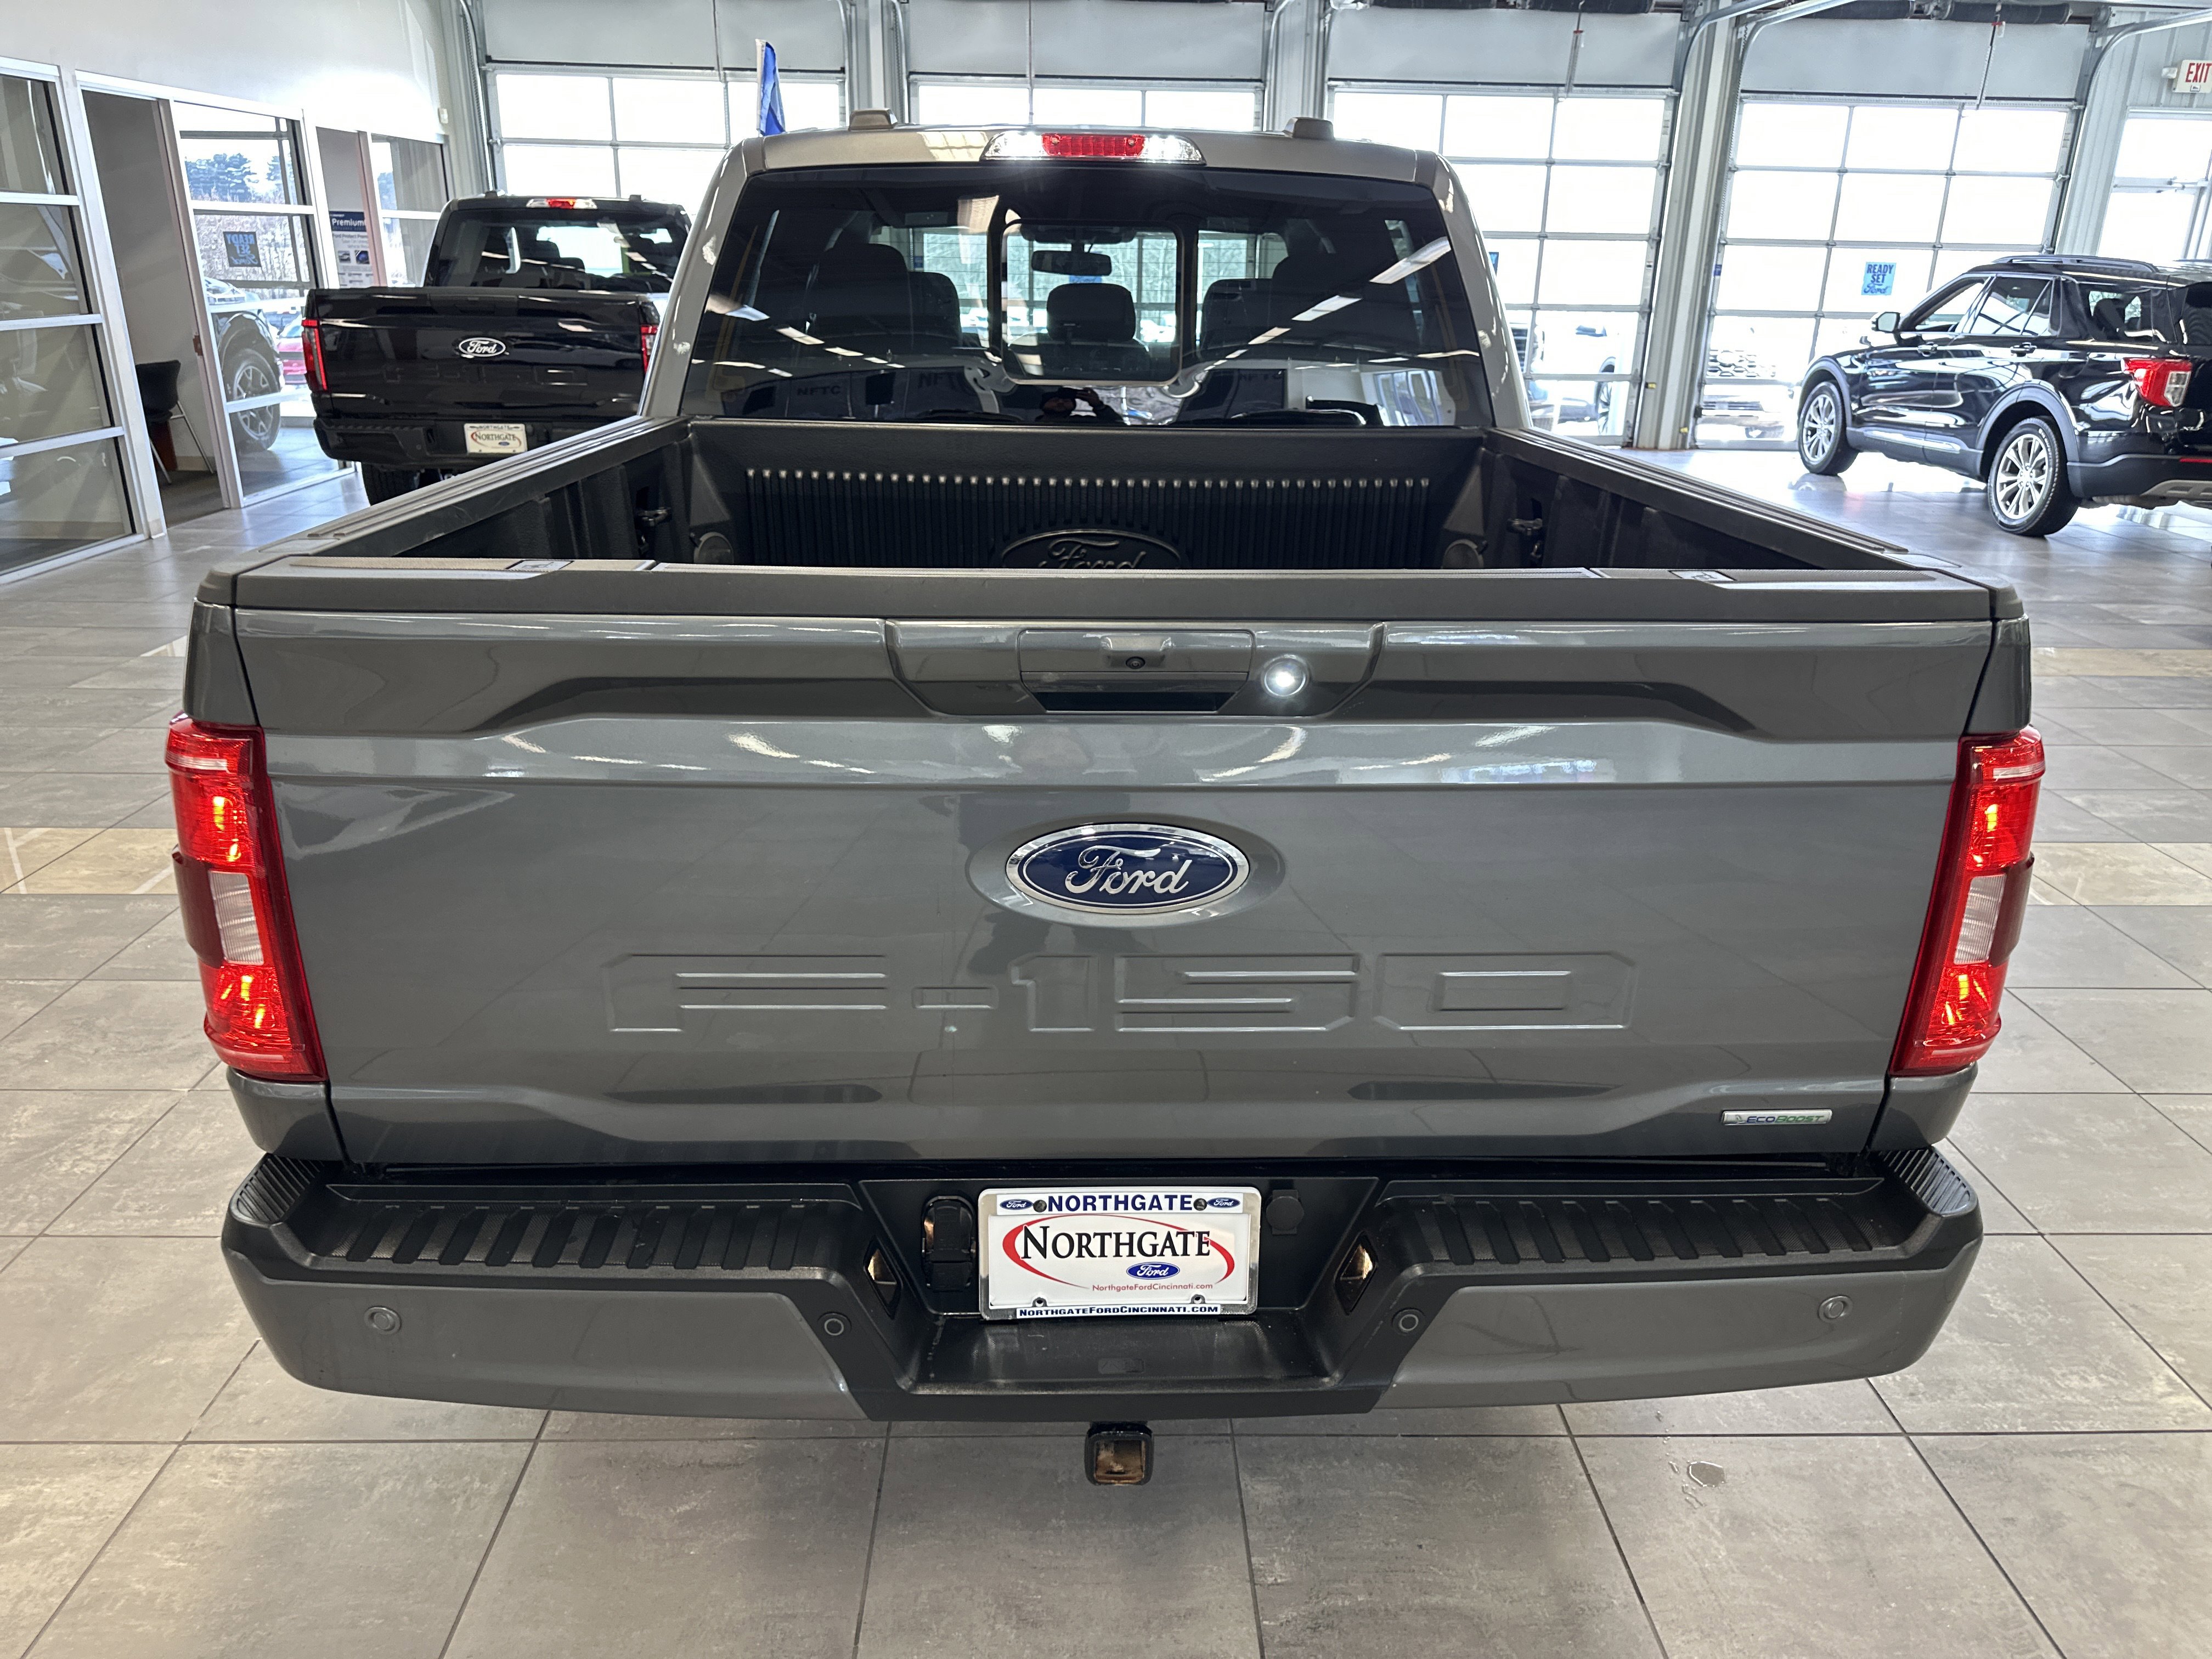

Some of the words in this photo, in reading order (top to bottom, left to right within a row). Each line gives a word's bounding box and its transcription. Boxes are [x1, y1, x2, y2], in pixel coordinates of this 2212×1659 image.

[2186, 63, 2212, 82] EXIT
[332, 218, 366, 227] Premium
[1867, 264, 1894, 274] READY
[1871, 274, 1886, 283] SET
[1864, 283, 1888, 294] Ford
[467, 340, 497, 353] Ford
[797, 385, 841, 396] NFTC
[1065, 845, 1192, 894] Ford
[605, 953, 1639, 1031] F-150
[1048, 1194, 1192, 1211] NORTHGATE
[1137, 1265, 1169, 1276] Ford
[1092, 1283, 1213, 1292] NorthgateFordCincinnati.com
